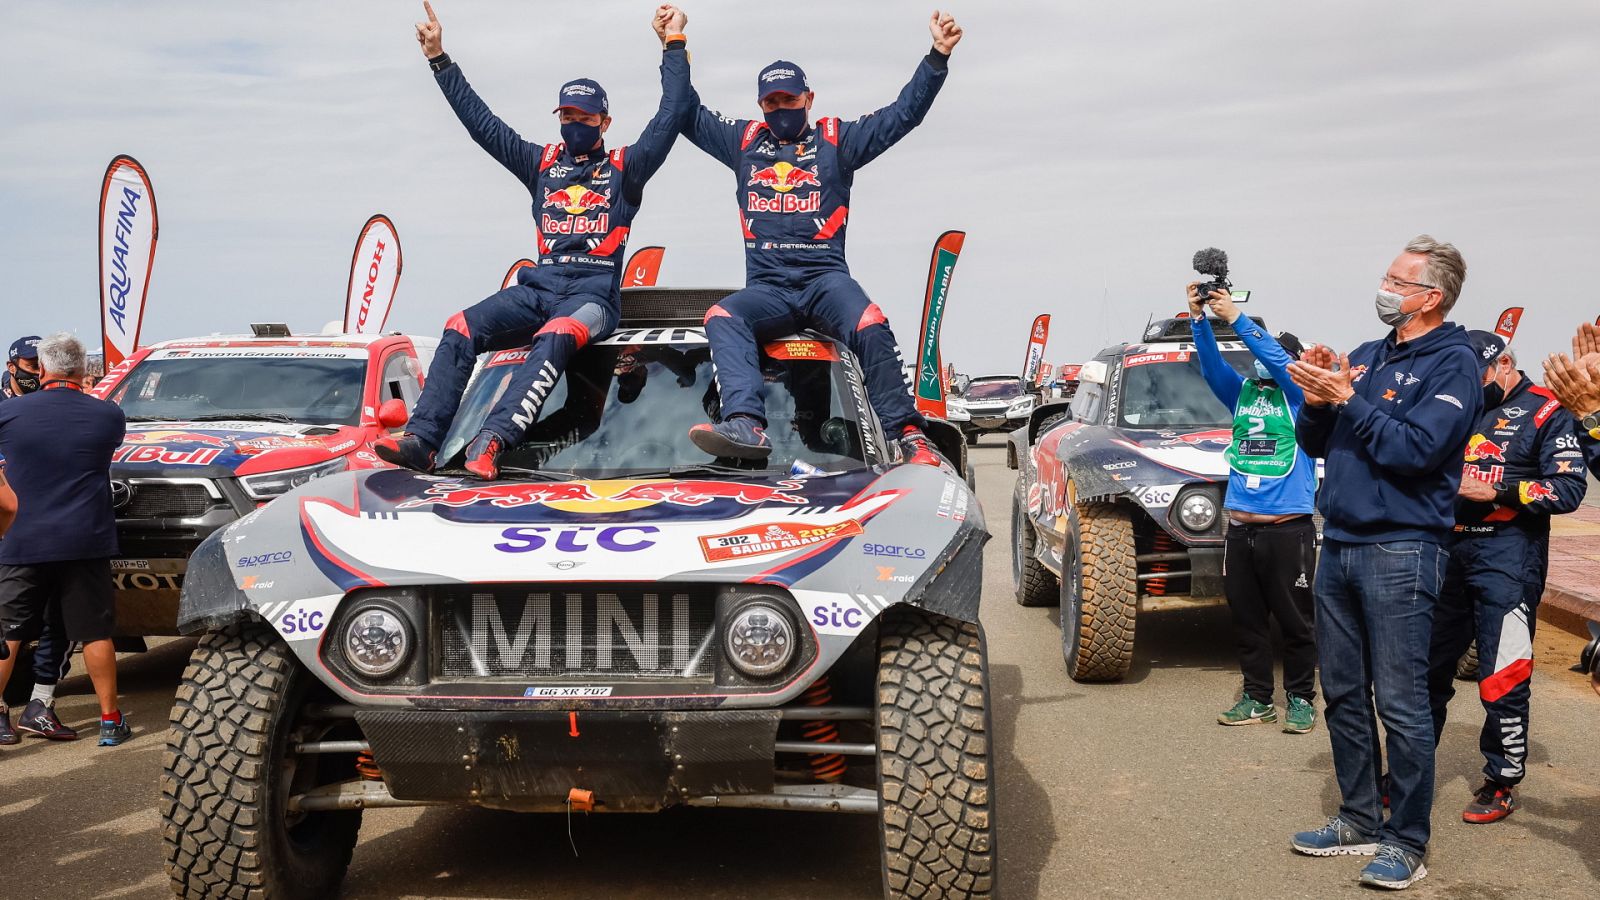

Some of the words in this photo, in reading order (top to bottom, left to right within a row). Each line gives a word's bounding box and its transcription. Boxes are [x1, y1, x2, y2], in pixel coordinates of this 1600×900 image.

[747, 191, 782, 212] Red
[783, 190, 821, 213] Bull
[542, 213, 572, 235] Red
[573, 213, 609, 235] Bull
[109, 186, 142, 336] AQUAFINA
[578, 257, 615, 267] BOULANGER
[632, 266, 646, 287] IC
[935, 264, 952, 315] ARABIA
[1128, 354, 1165, 365] MOTUL
[1482, 344, 1498, 359] stc
[511, 359, 559, 432] MINI
[840, 350, 877, 455] www.x-raid.de
[1247, 417, 1268, 439] 2
[124, 445, 222, 466] Bull
[1103, 460, 1138, 471] sparco
[1466, 463, 1504, 485] Bull
[1144, 490, 1171, 504] stc
[493, 525, 660, 553] stc
[717, 535, 751, 547] 302
[731, 544, 777, 555] SAUDI
[781, 531, 838, 549] ARABIA
[237, 550, 293, 568] sparco
[862, 542, 926, 559] sparco
[281, 608, 324, 634] stc
[812, 602, 862, 628] stc
[471, 593, 690, 669] MINI
[539, 688, 559, 696] GG
[560, 688, 580, 696] XR
[583, 688, 608, 696] 707
[1499, 716, 1525, 778] MINI
